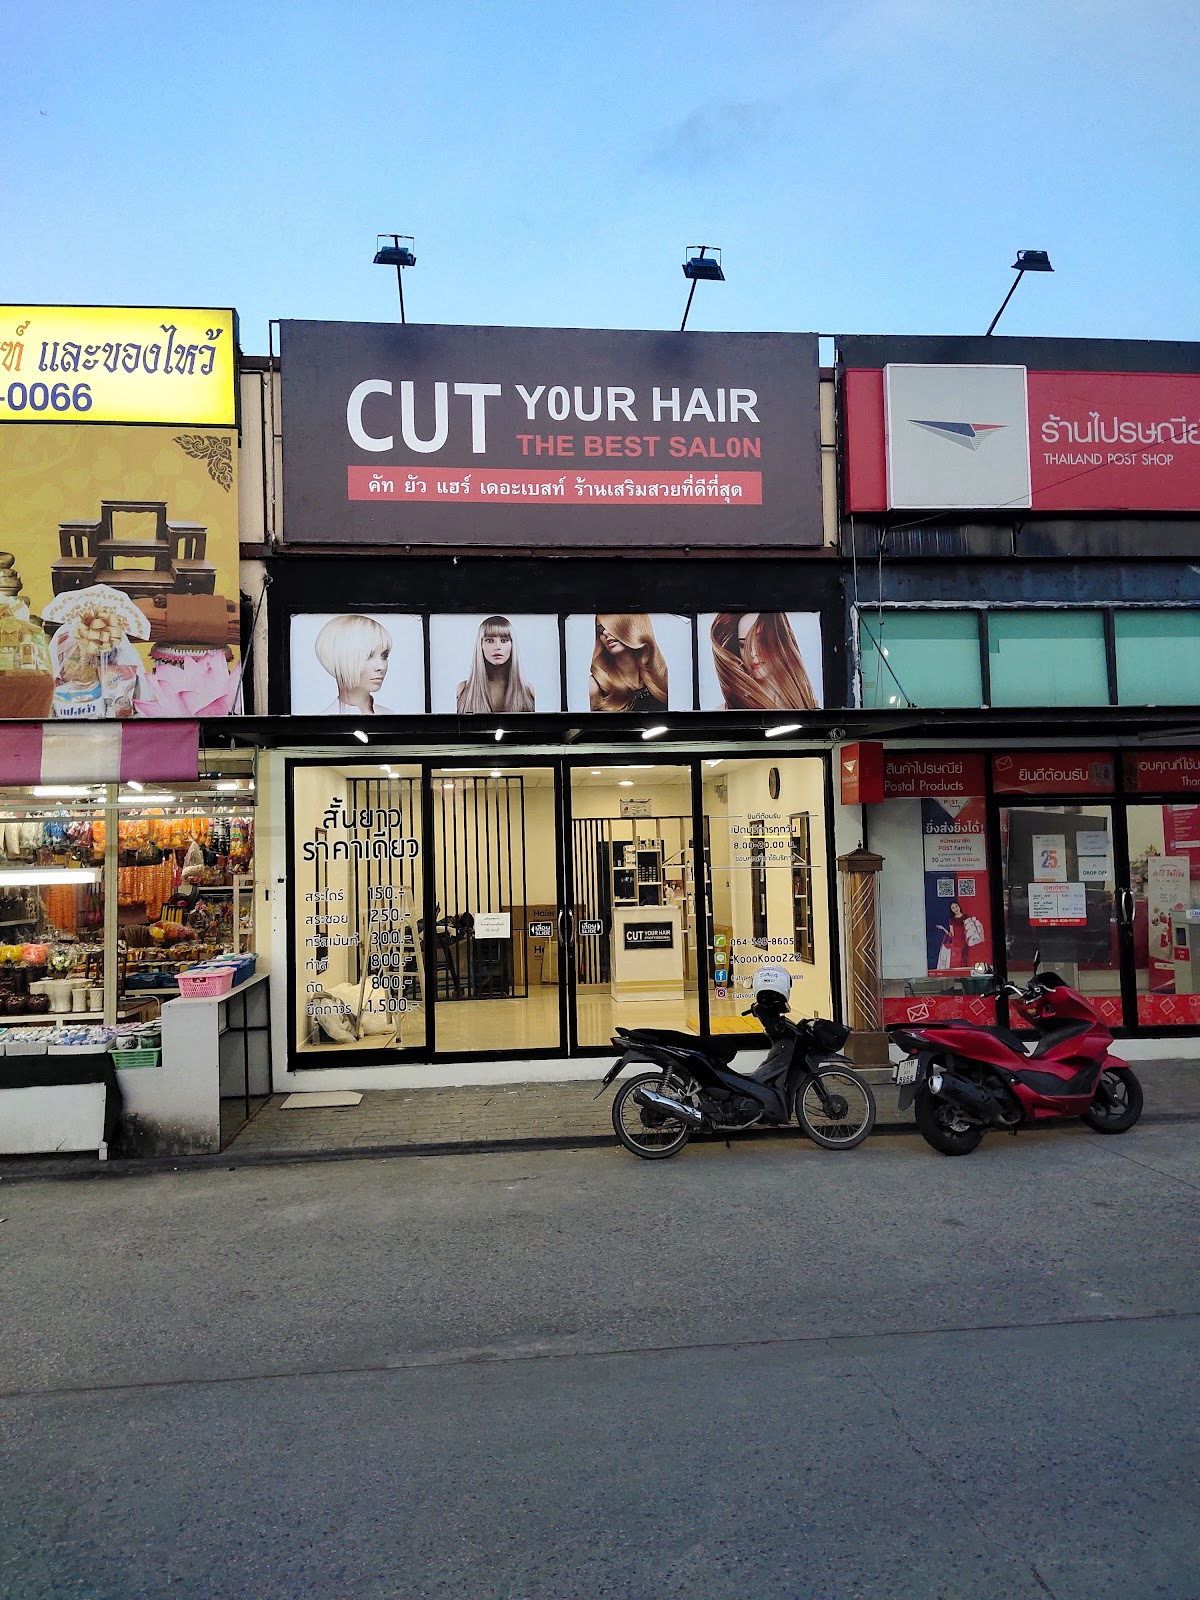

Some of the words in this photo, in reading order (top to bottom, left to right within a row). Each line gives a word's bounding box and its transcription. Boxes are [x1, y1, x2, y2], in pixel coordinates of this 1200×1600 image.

[38, 324, 224, 376] และของไหว้
[346, 379, 502, 454] CUT
[652, 387, 761, 423] HAIR
[1041, 410, 1200, 444] ร้านไปรษณีย
[516, 434, 575, 457] THE
[584, 435, 661, 457] BEST
[1043, 453, 1103, 465] THAILAND
[1107, 453, 1138, 466] POST
[1141, 453, 1174, 466] SHOP
[368, 473, 394, 493] คัท
[404, 474, 427, 494] ยัว
[437, 474, 473, 495] แฮร์
[480, 475, 567, 496] เดอะเบสท์
[574, 473, 743, 504] ร้านเสริมสวยที่ดีที่สุด
[886, 761, 963, 775] สินค้าไปรษณีย์
[1018, 768, 1089, 781] ยินดีต้อนรับ
[884, 778, 915, 792] Postal
[920, 779, 964, 791] Products
[322, 796, 402, 829] สั้นยาว
[731, 824, 797, 837] เปิดบริการทุกวัน
[926, 819, 984, 833] ยิ่งส่งยิ่งได้!
[303, 831, 419, 861] ราคาเดียว
[370, 908, 411, 923] 250.-
[533, 909, 555, 917] Haier
[370, 930, 412, 945] 300.-
[626, 930, 643, 940] CUT
[370, 952, 413, 968] 800.-
[371, 975, 413, 990] 800.-
[367, 998, 419, 1014] 1,500.-
